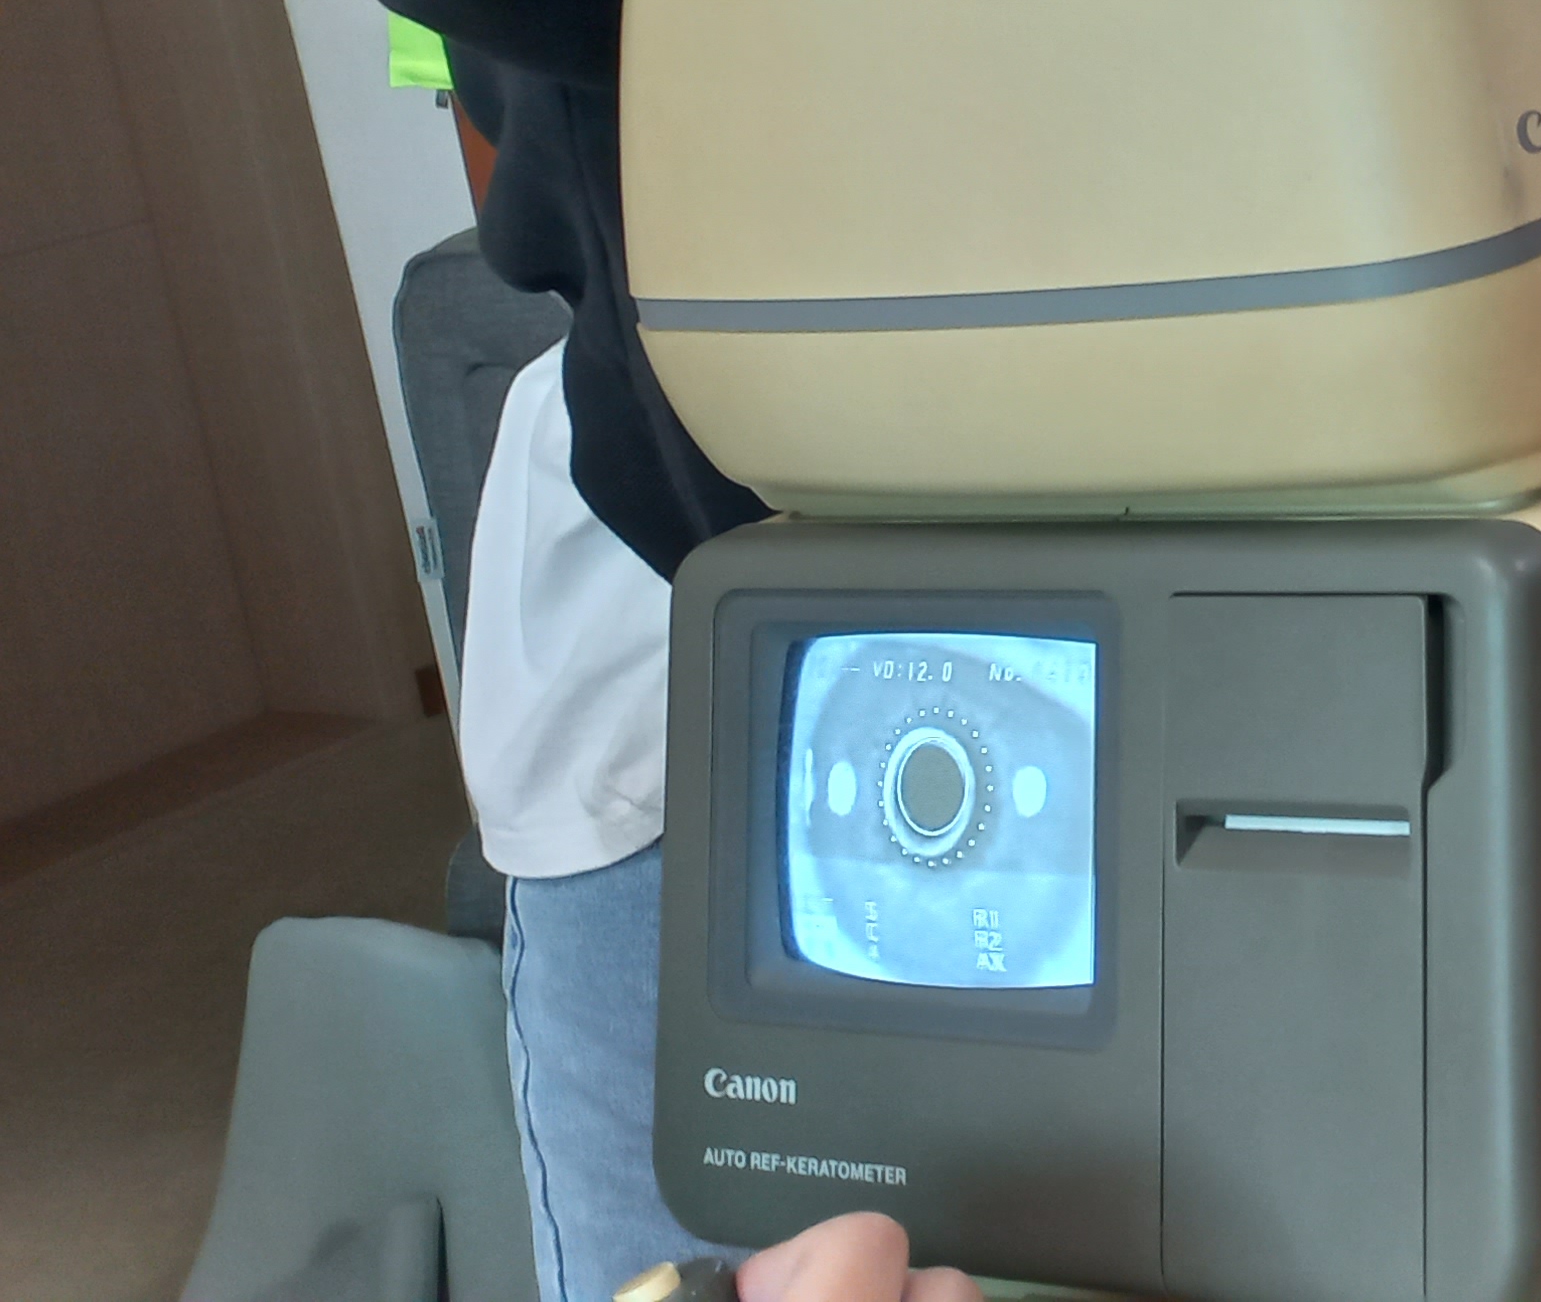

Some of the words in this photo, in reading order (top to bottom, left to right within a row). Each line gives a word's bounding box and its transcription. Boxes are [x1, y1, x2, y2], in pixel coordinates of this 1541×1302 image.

[704, 1067, 797, 1105] Canon
[703, 1147, 746, 1169] AUTO
[751, 1152, 907, 1186] REF-KERATOMETER
